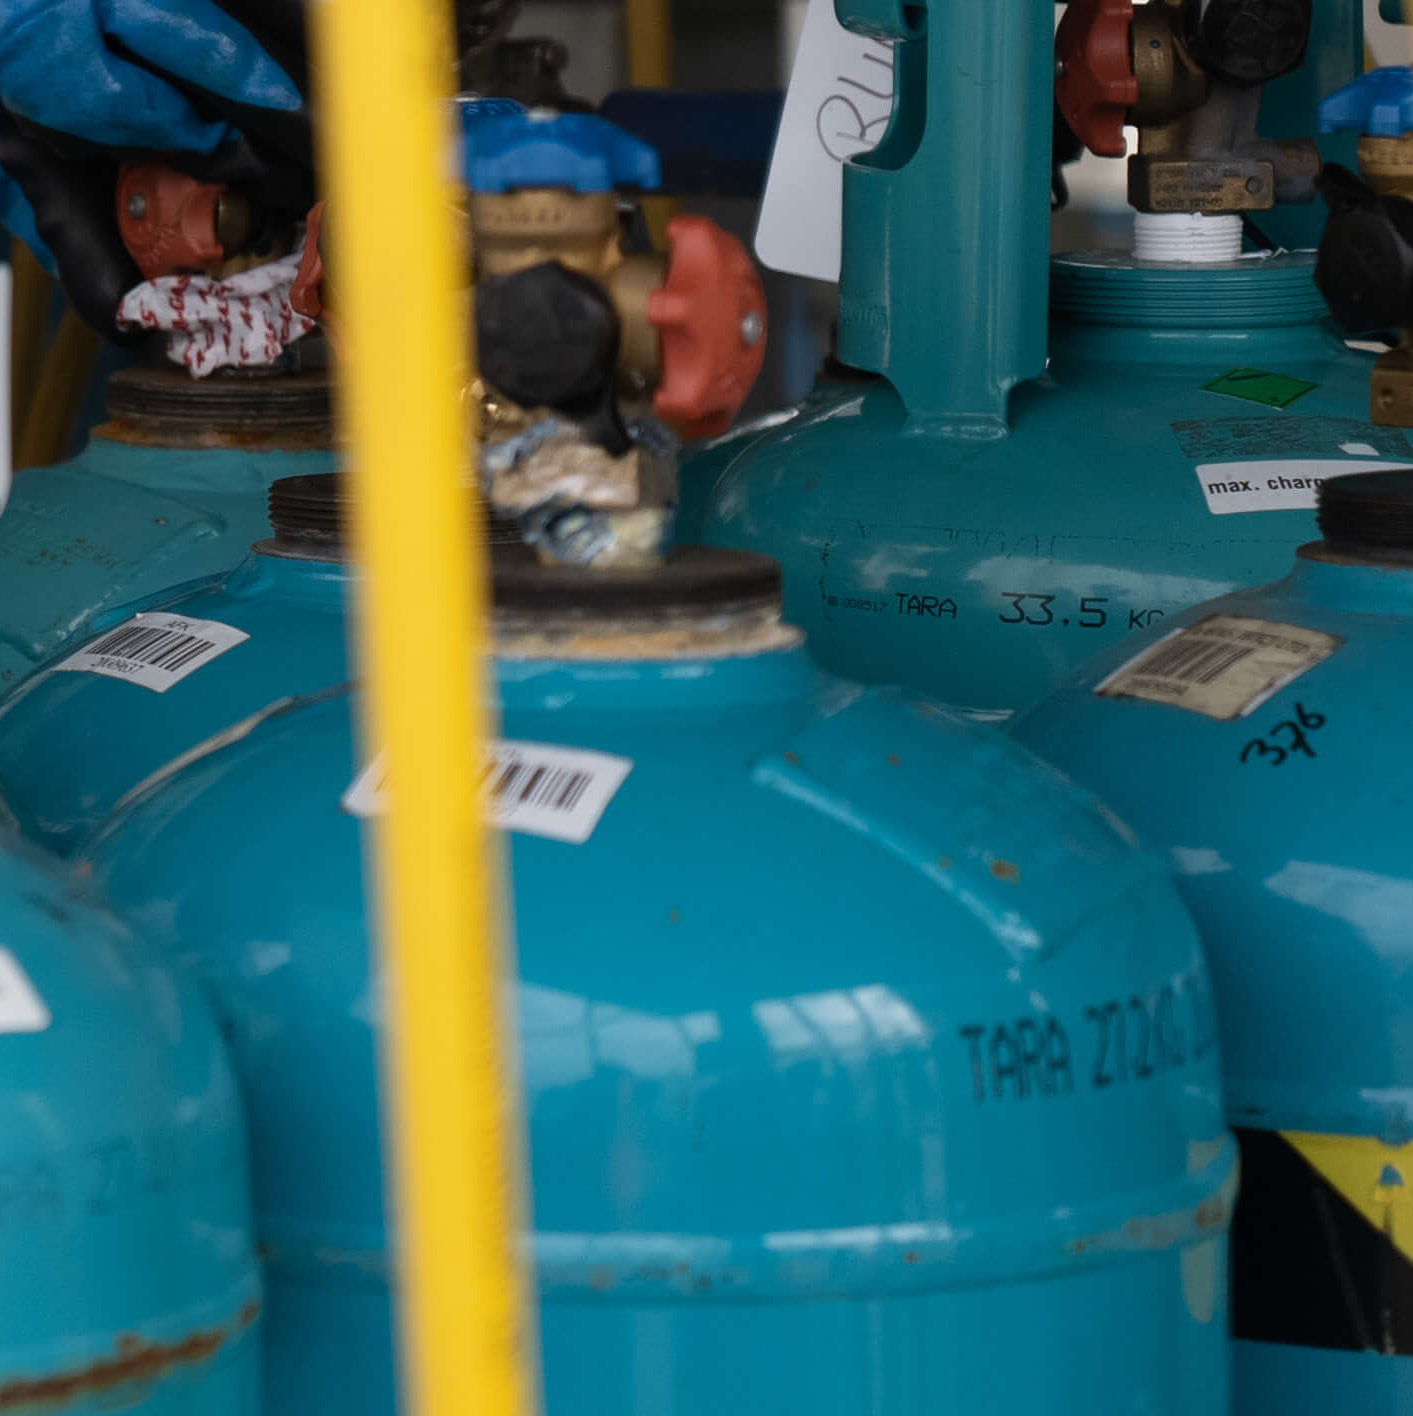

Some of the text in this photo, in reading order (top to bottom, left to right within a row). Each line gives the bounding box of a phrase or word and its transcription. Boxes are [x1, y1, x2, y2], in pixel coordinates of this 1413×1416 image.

[1207, 479, 1261, 496] max.
[895, 592, 958, 620] TARA
[998, 590, 1108, 629] 33.5
[1238, 702, 1326, 766] 376
[958, 1016, 1071, 1102] TARA
